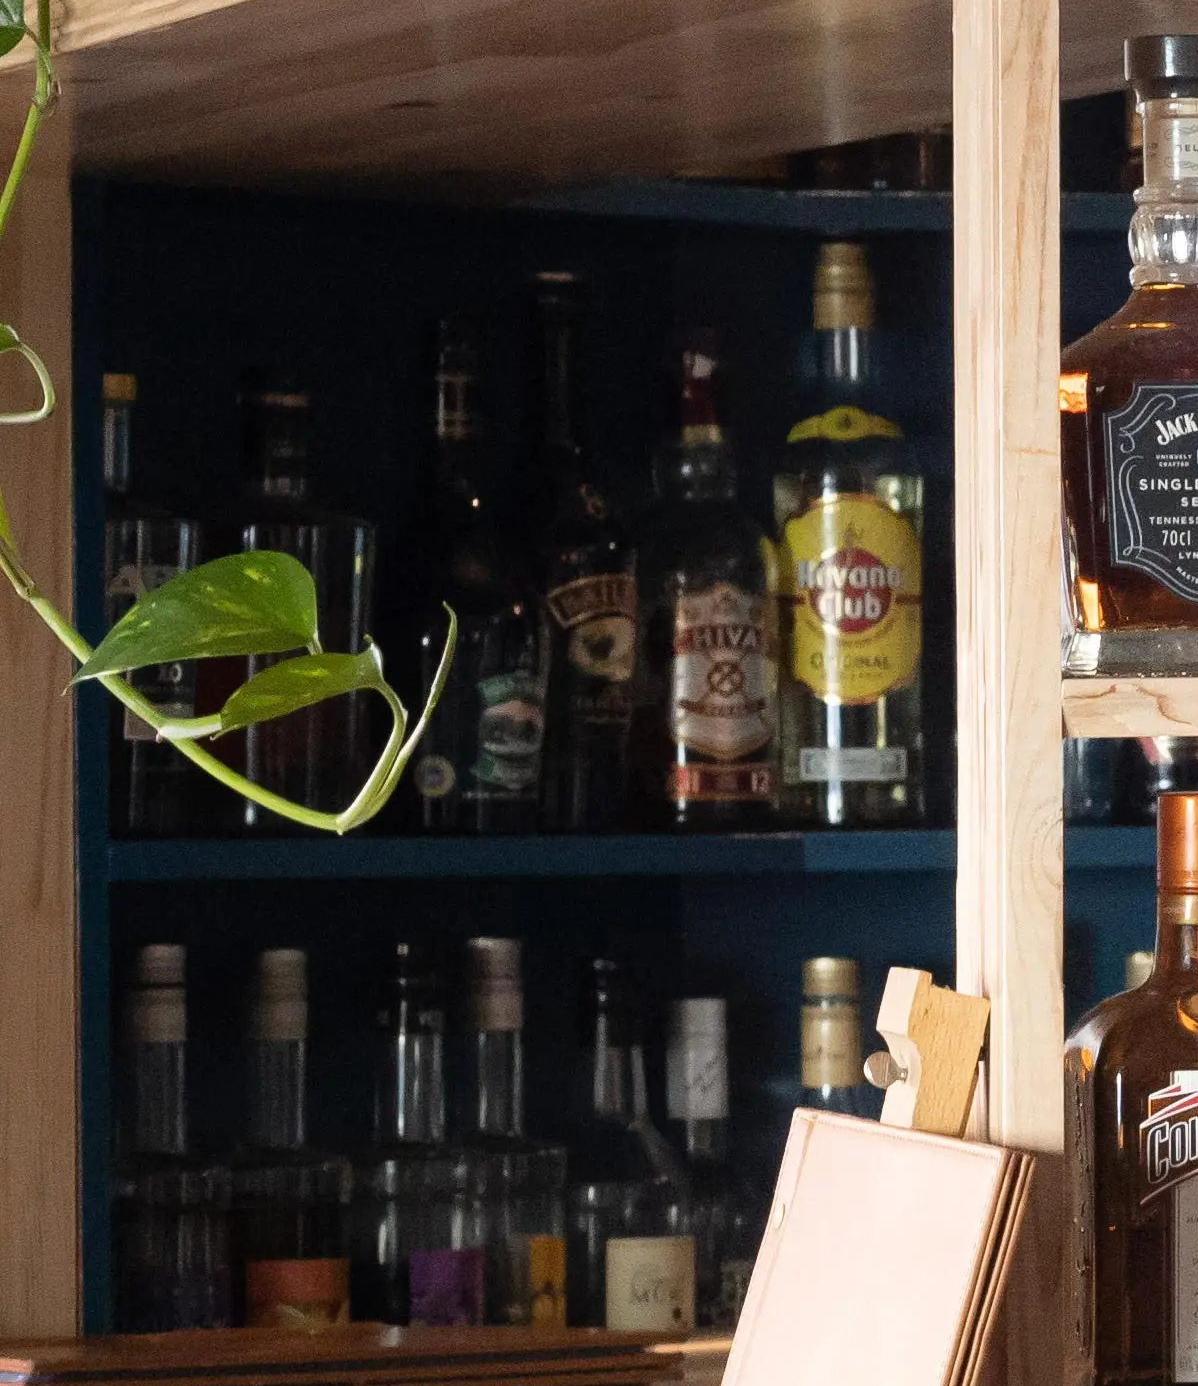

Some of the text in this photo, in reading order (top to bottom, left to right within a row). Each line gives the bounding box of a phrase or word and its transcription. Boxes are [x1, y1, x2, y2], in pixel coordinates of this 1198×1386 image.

[1155, 412, 1198, 446] JACK
[1161, 529, 1191, 546] 70cl
[796, 559, 902, 589] Havana
[817, 589, 882, 622] Club
[809, 652, 890, 670] OGINAL
